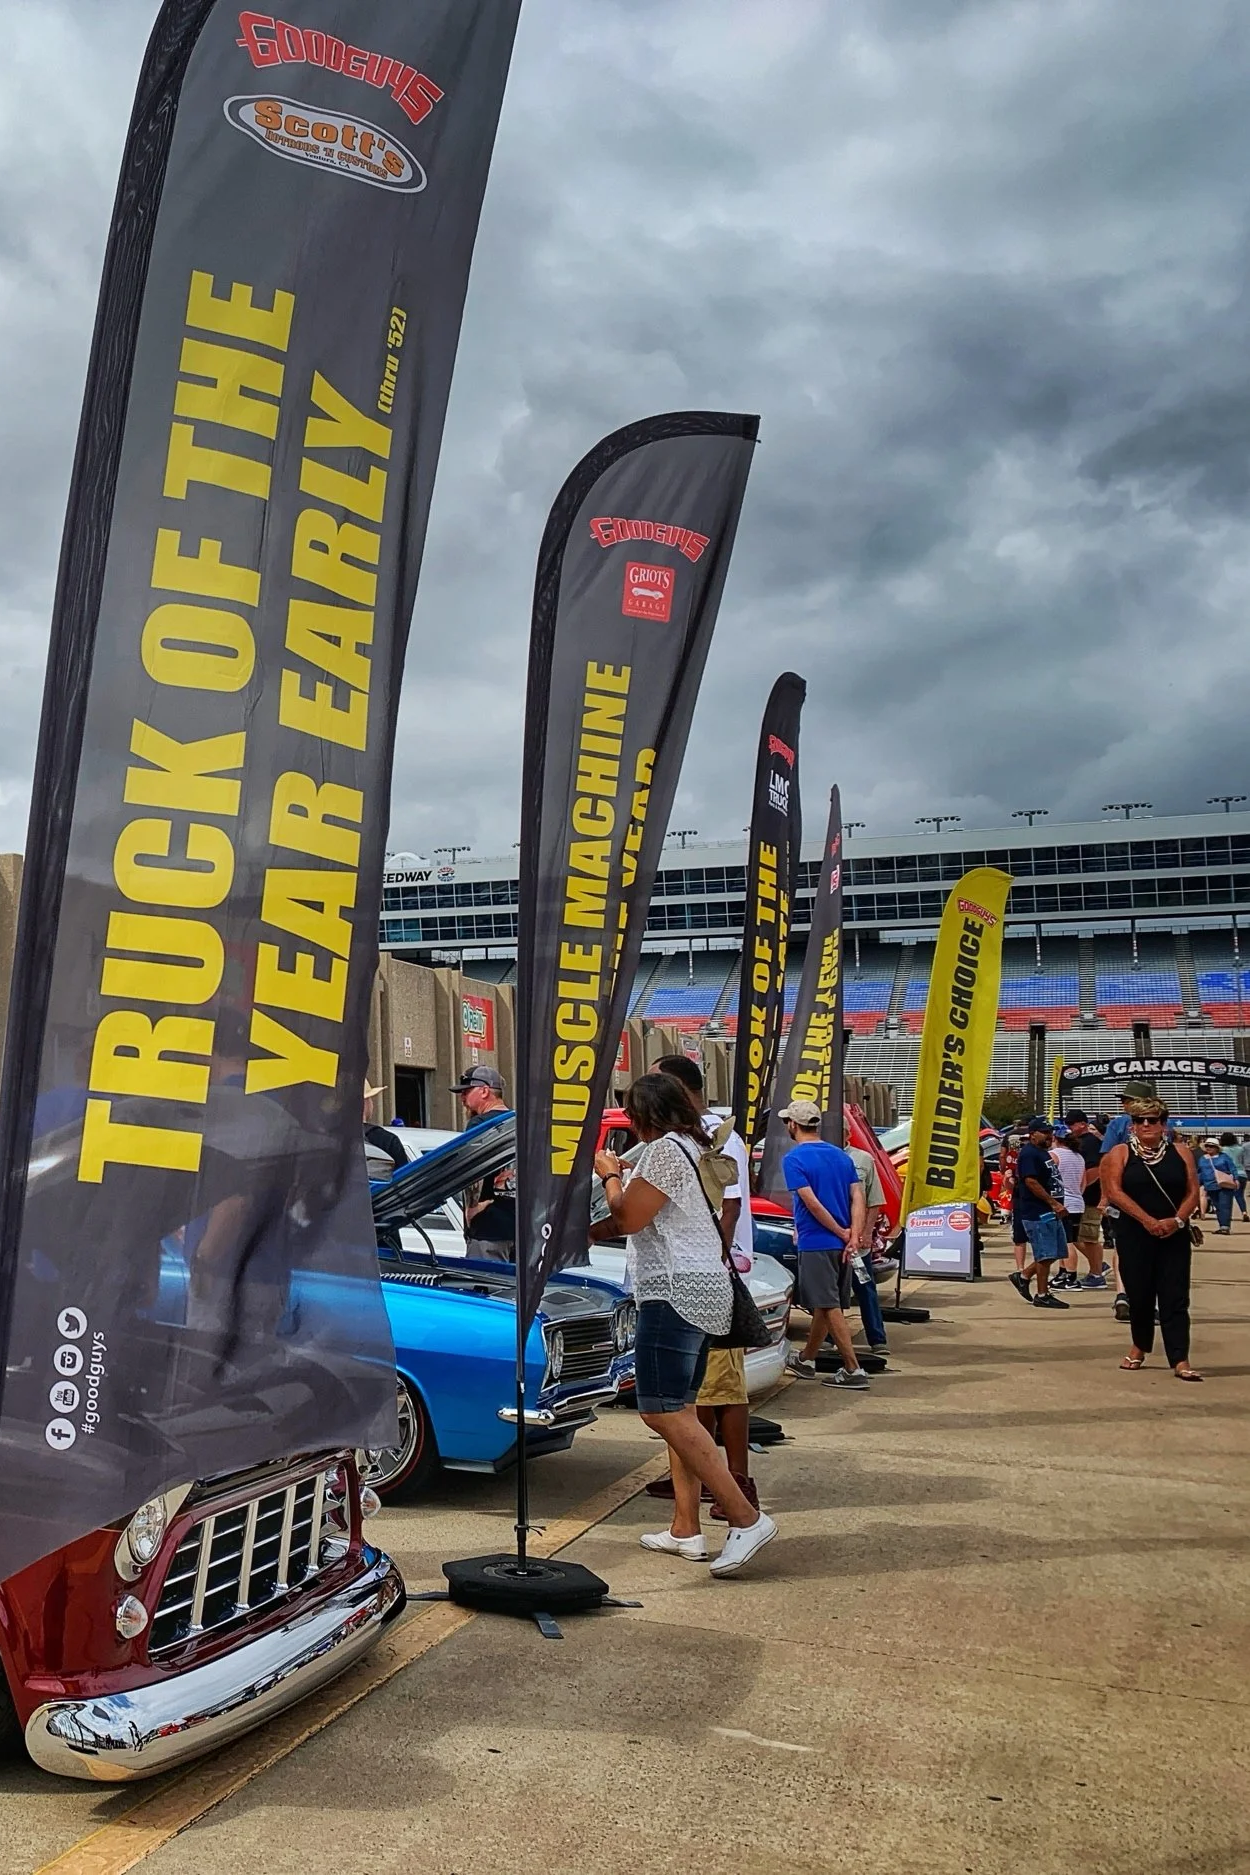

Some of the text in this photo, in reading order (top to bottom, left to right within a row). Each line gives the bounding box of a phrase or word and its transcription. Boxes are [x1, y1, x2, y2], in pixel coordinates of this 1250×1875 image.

[236, 11, 445, 125] GOODGUYS
[254, 100, 405, 177] Scott's
[265, 129, 320, 154] HOTRODS
[337, 151, 389, 180] CUSTOMS
[590, 517, 711, 563] GOODGUYS
[630, 566, 670, 589] GRIOT'S
[77, 269, 296, 1184] TRUCK OF THE
[244, 370, 394, 1095] YEAR EARLY
[383, 870, 433, 884] EEDWAY
[551, 660, 631, 1175] MUSCLE MACHINE
[756, 841, 778, 926] THE
[753, 935, 774, 993] OF
[926, 1033, 965, 1190] BUILDER'S
[949, 916, 984, 1030] CHOICE
[1080, 1063, 1110, 1075] TEXAS
[1113, 1060, 1206, 1074] GARAGE
[1227, 1064, 1250, 1076] TEXA
[81, 1331, 107, 1435] #goodguys
